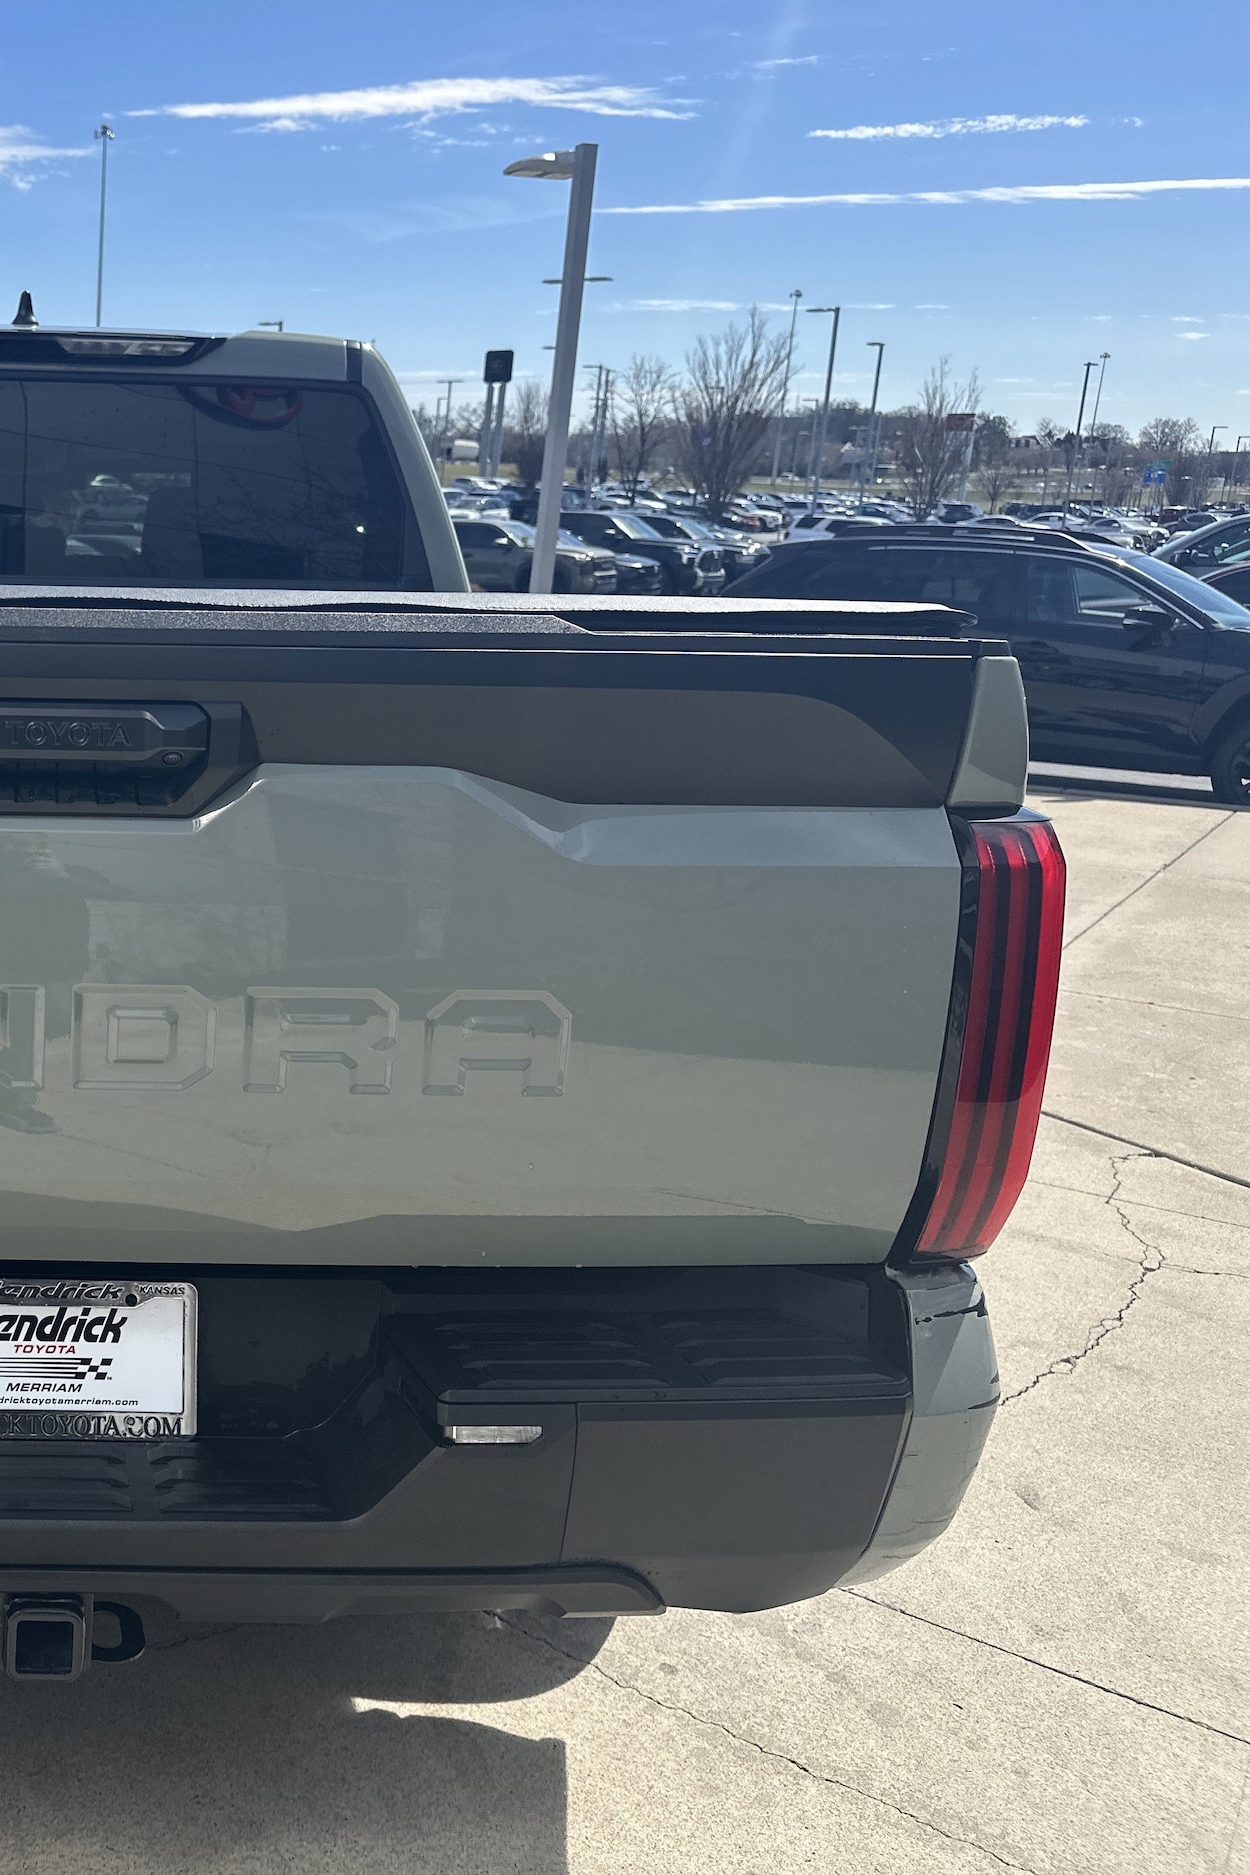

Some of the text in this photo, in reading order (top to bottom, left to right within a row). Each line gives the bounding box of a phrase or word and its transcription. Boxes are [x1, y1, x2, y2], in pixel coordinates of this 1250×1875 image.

[4, 720, 133, 747] TOYOTA
[138, 1285, 186, 1295] KANSAS
[13, 1344, 76, 1354] TOYOTA
[5, 1382, 83, 1393] MERRIAM
